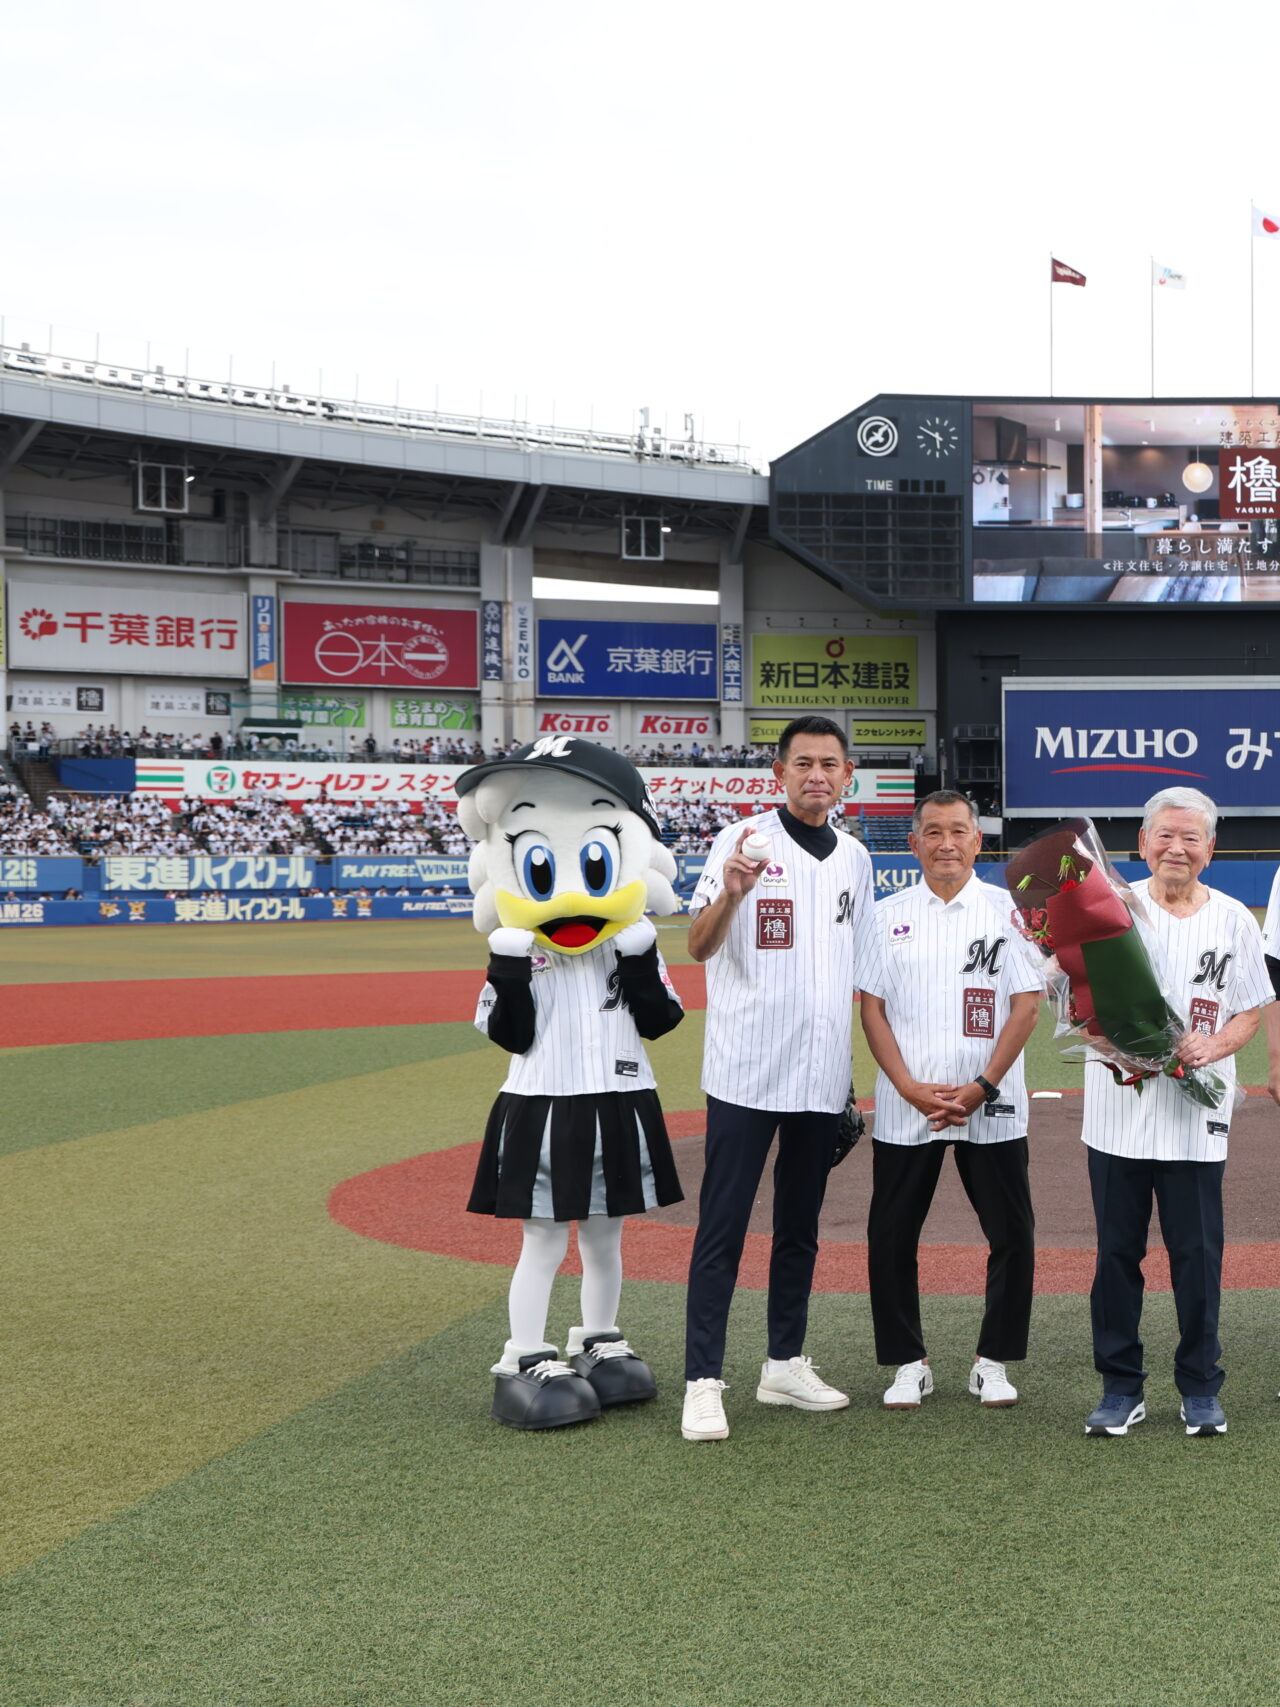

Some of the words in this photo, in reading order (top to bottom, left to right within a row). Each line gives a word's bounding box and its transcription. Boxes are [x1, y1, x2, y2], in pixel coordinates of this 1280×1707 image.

[866, 480, 893, 491] TIME
[63, 612, 238, 650] 千葉銀行
[518, 618, 529, 678] ZENKO
[607, 647, 713, 675] 京葉銀行
[724, 645, 741, 700] 大森工業
[548, 672, 585, 683] BANK
[760, 661, 910, 690] 新日本建設
[394, 700, 449, 714] そらまめ
[761, 695, 837, 705] INTELLIGENT
[842, 696, 910, 705] DEVELOPER
[394, 713, 438, 726] 保育園
[855, 728, 923, 737] エクセレントシティ
[525, 735, 577, 760] M
[104, 857, 313, 890] 東進ハイスクール
[342, 864, 379, 877] PLAY
[421, 864, 449, 875] WIN
[175, 898, 306, 920] 東進ハイスクール
[959, 934, 1008, 977] M
[1189, 947, 1232, 992] M
